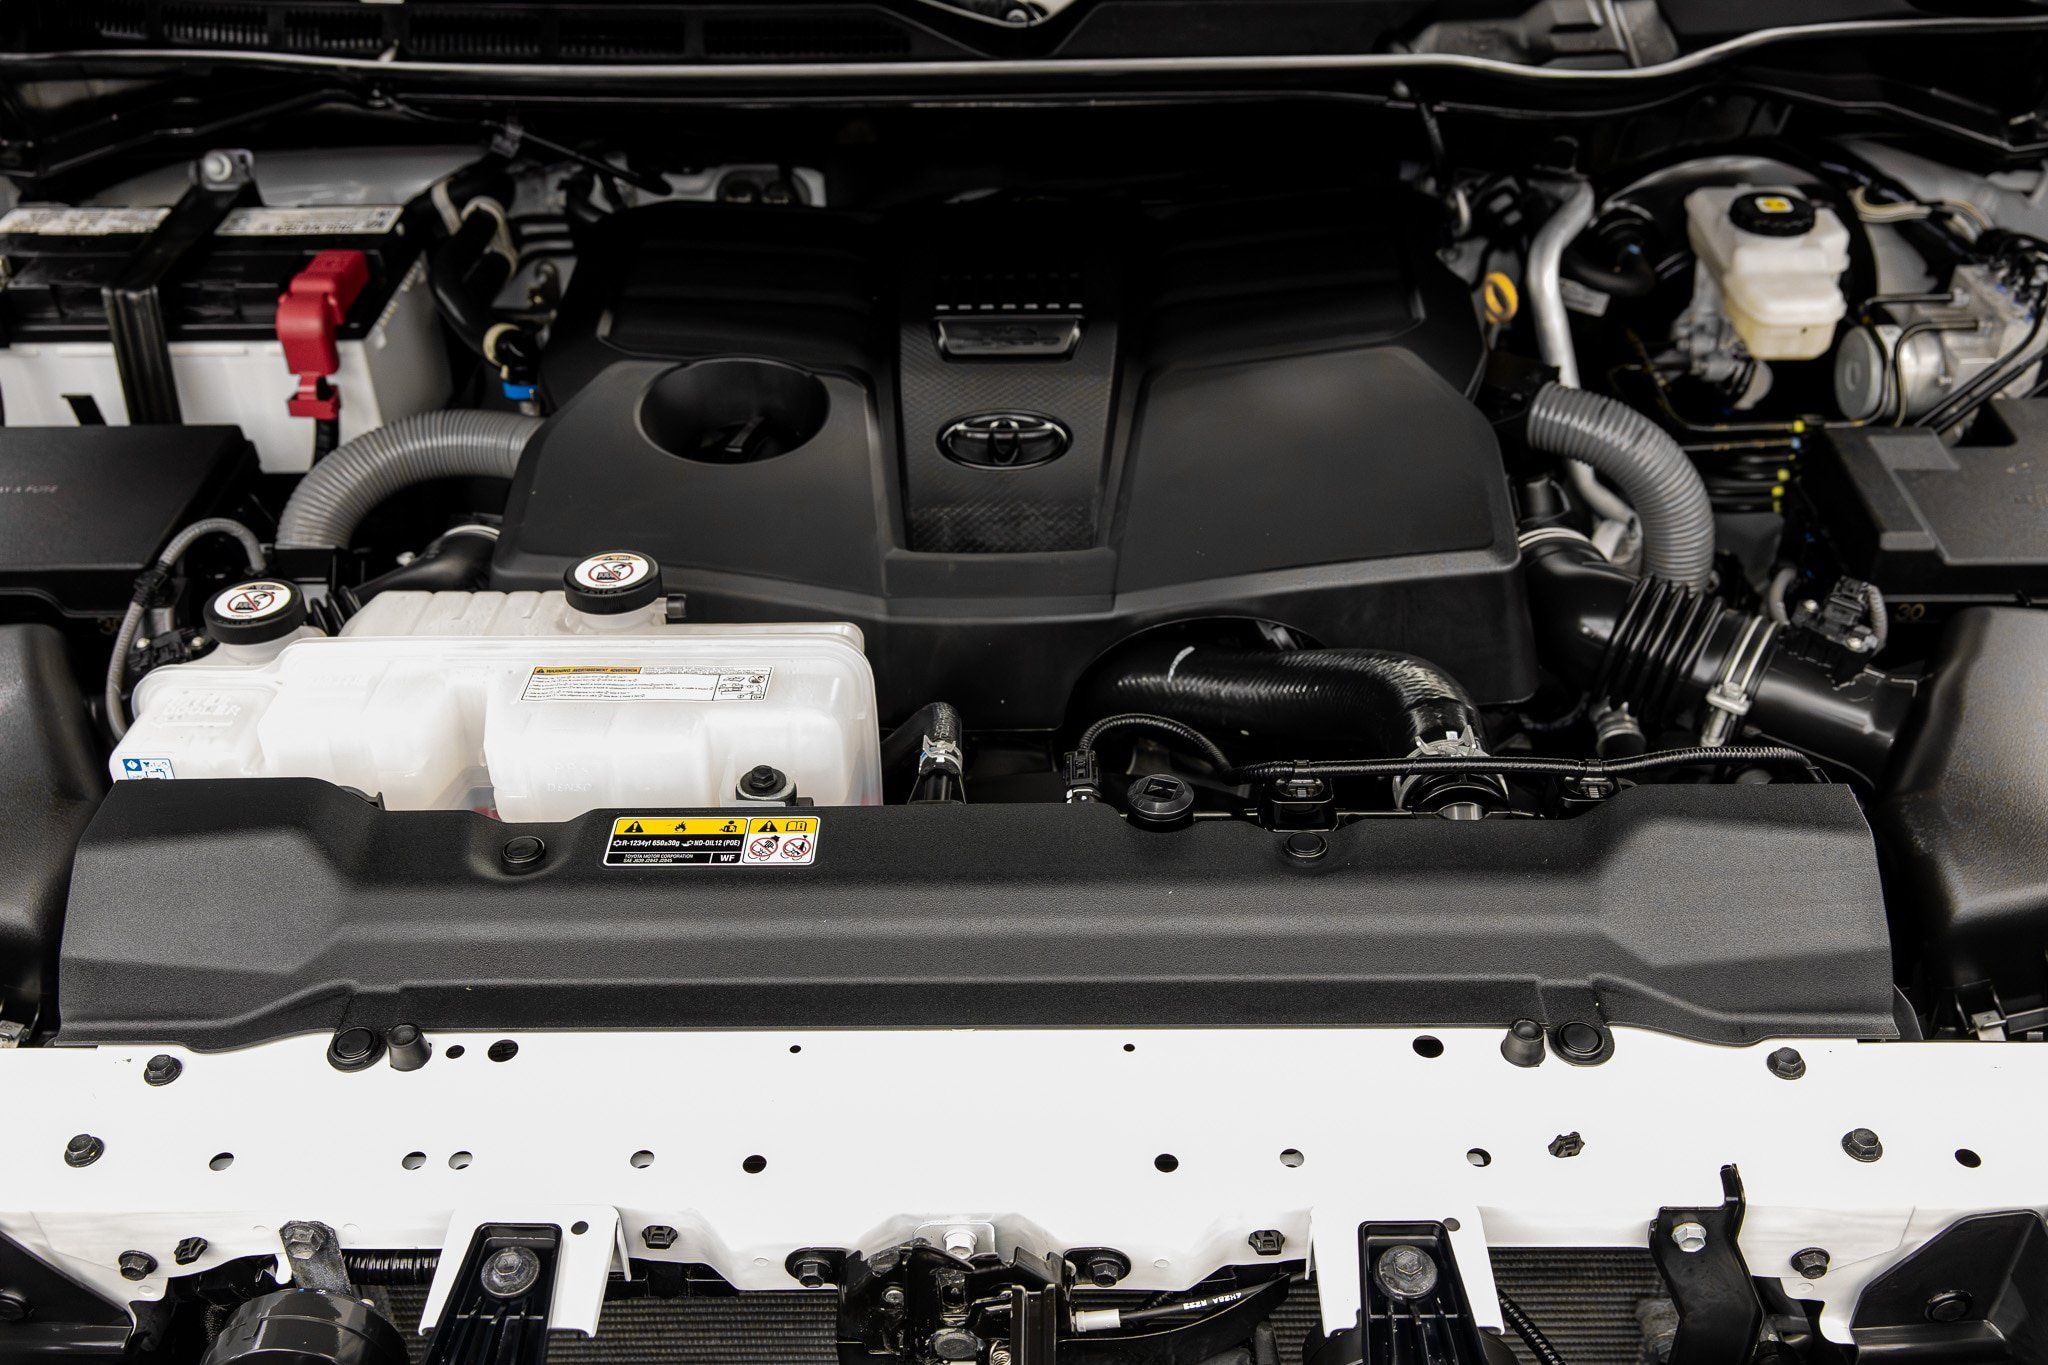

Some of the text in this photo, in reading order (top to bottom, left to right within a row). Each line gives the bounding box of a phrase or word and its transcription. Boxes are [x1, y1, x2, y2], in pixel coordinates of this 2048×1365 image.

[1895, 602, 1926, 623] 30
[723, 839, 741, 847] (POE)
[720, 854, 735, 862] WF
